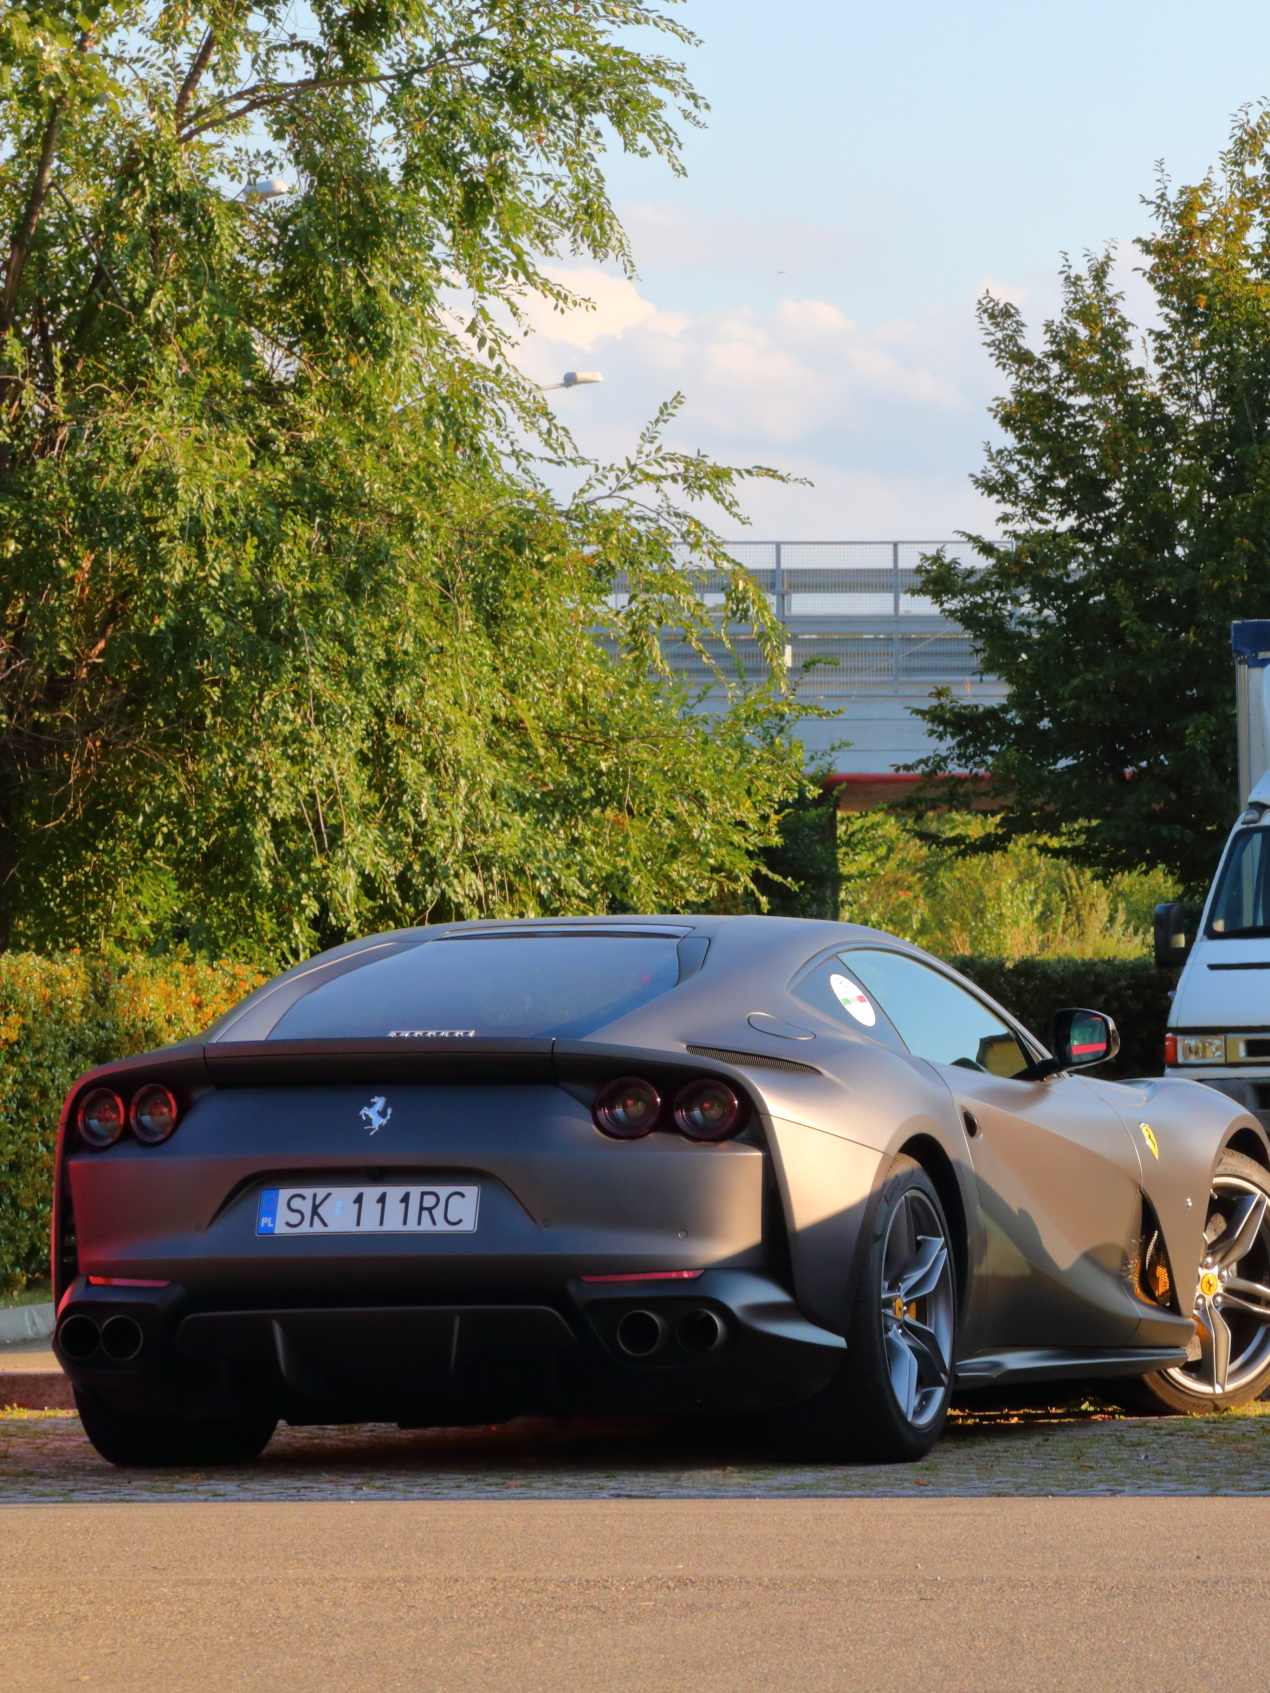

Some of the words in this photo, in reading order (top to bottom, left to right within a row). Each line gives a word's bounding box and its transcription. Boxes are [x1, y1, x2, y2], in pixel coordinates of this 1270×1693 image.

[284, 1192, 333, 1228] SK
[352, 1190, 466, 1227] 111RC
[261, 1217, 274, 1227] PL
